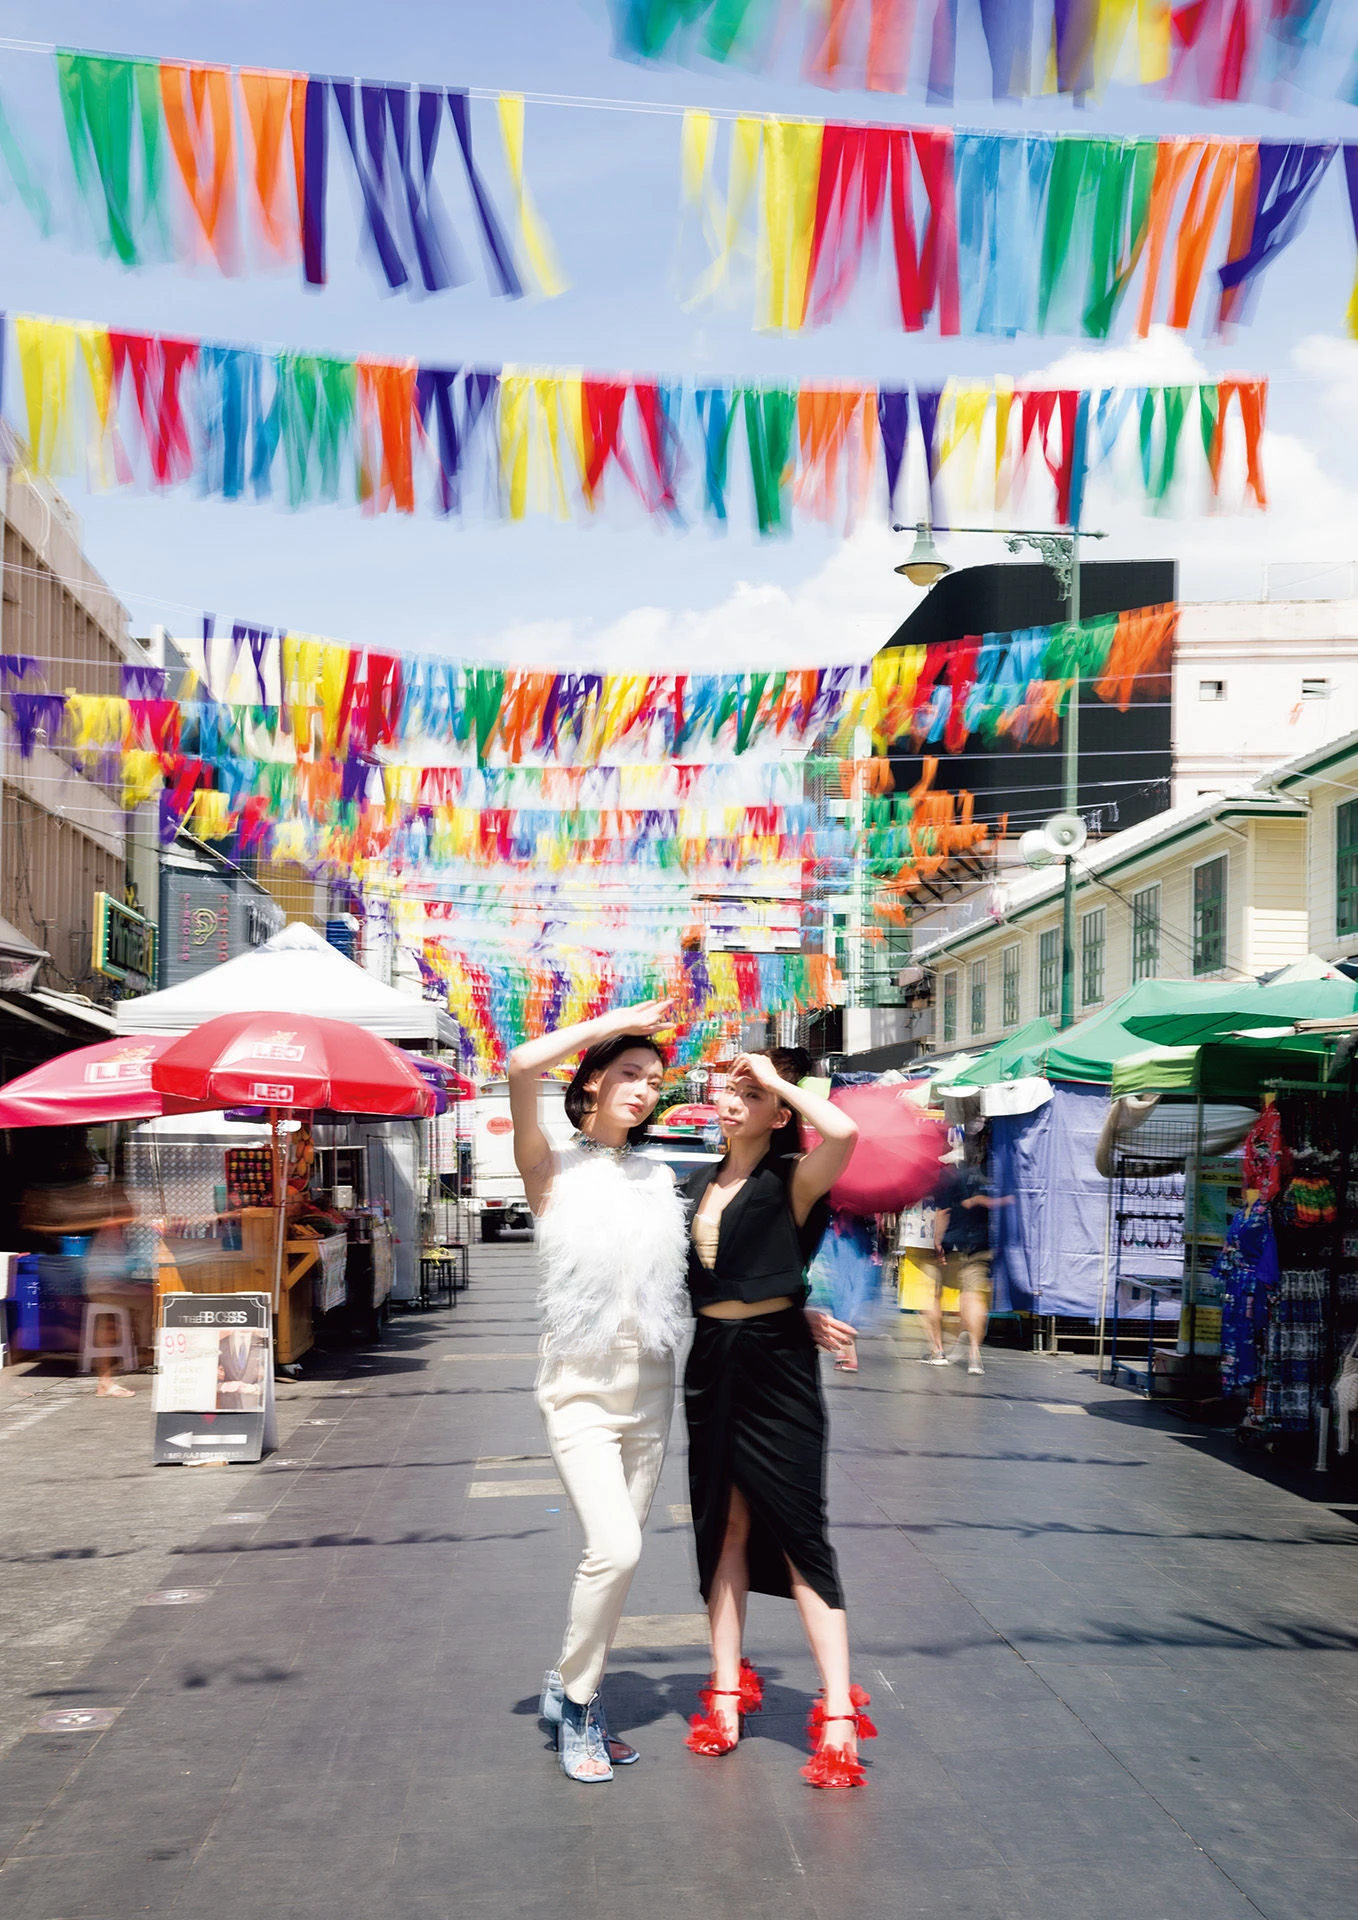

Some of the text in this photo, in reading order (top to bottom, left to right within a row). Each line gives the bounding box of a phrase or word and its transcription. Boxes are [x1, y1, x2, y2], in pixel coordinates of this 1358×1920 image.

[218, 894, 230, 962] TATTOO
[255, 1045, 301, 1059] LEO
[256, 1085, 292, 1100] LEO
[200, 1311, 248, 1324] BOSS
